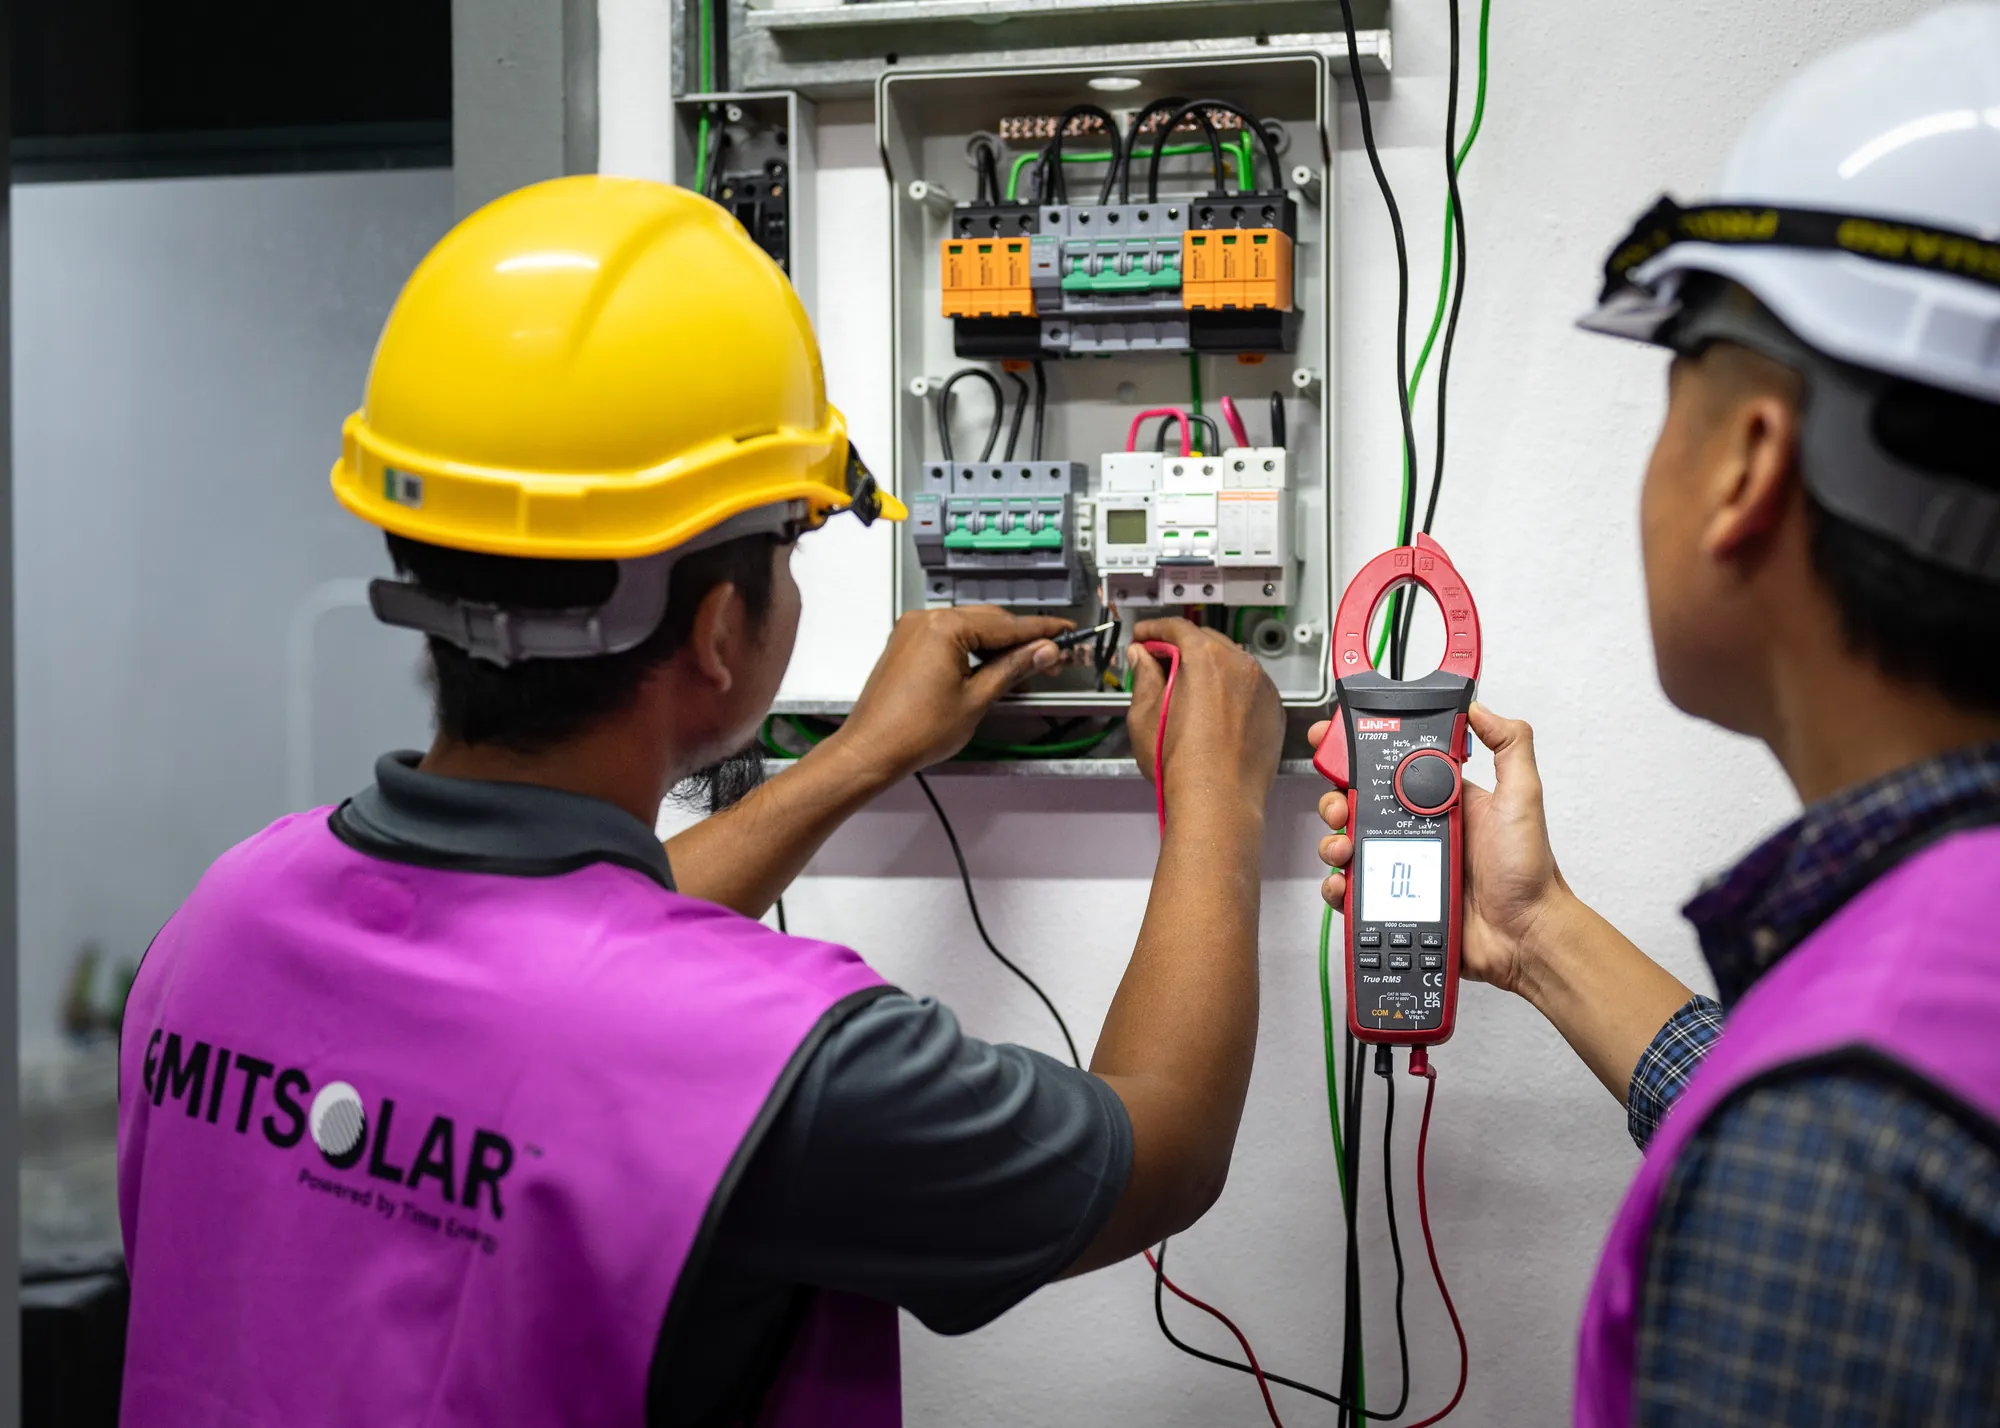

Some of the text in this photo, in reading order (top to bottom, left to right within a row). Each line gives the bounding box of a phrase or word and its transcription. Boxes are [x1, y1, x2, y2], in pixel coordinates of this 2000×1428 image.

[1363, 975, 1402, 983] True RMS
[1424, 991, 1440, 1000] UK
[1424, 1000, 1441, 1008] CA
[299, 1168, 373, 1208] Powered
[376, 1192, 397, 1219] by
